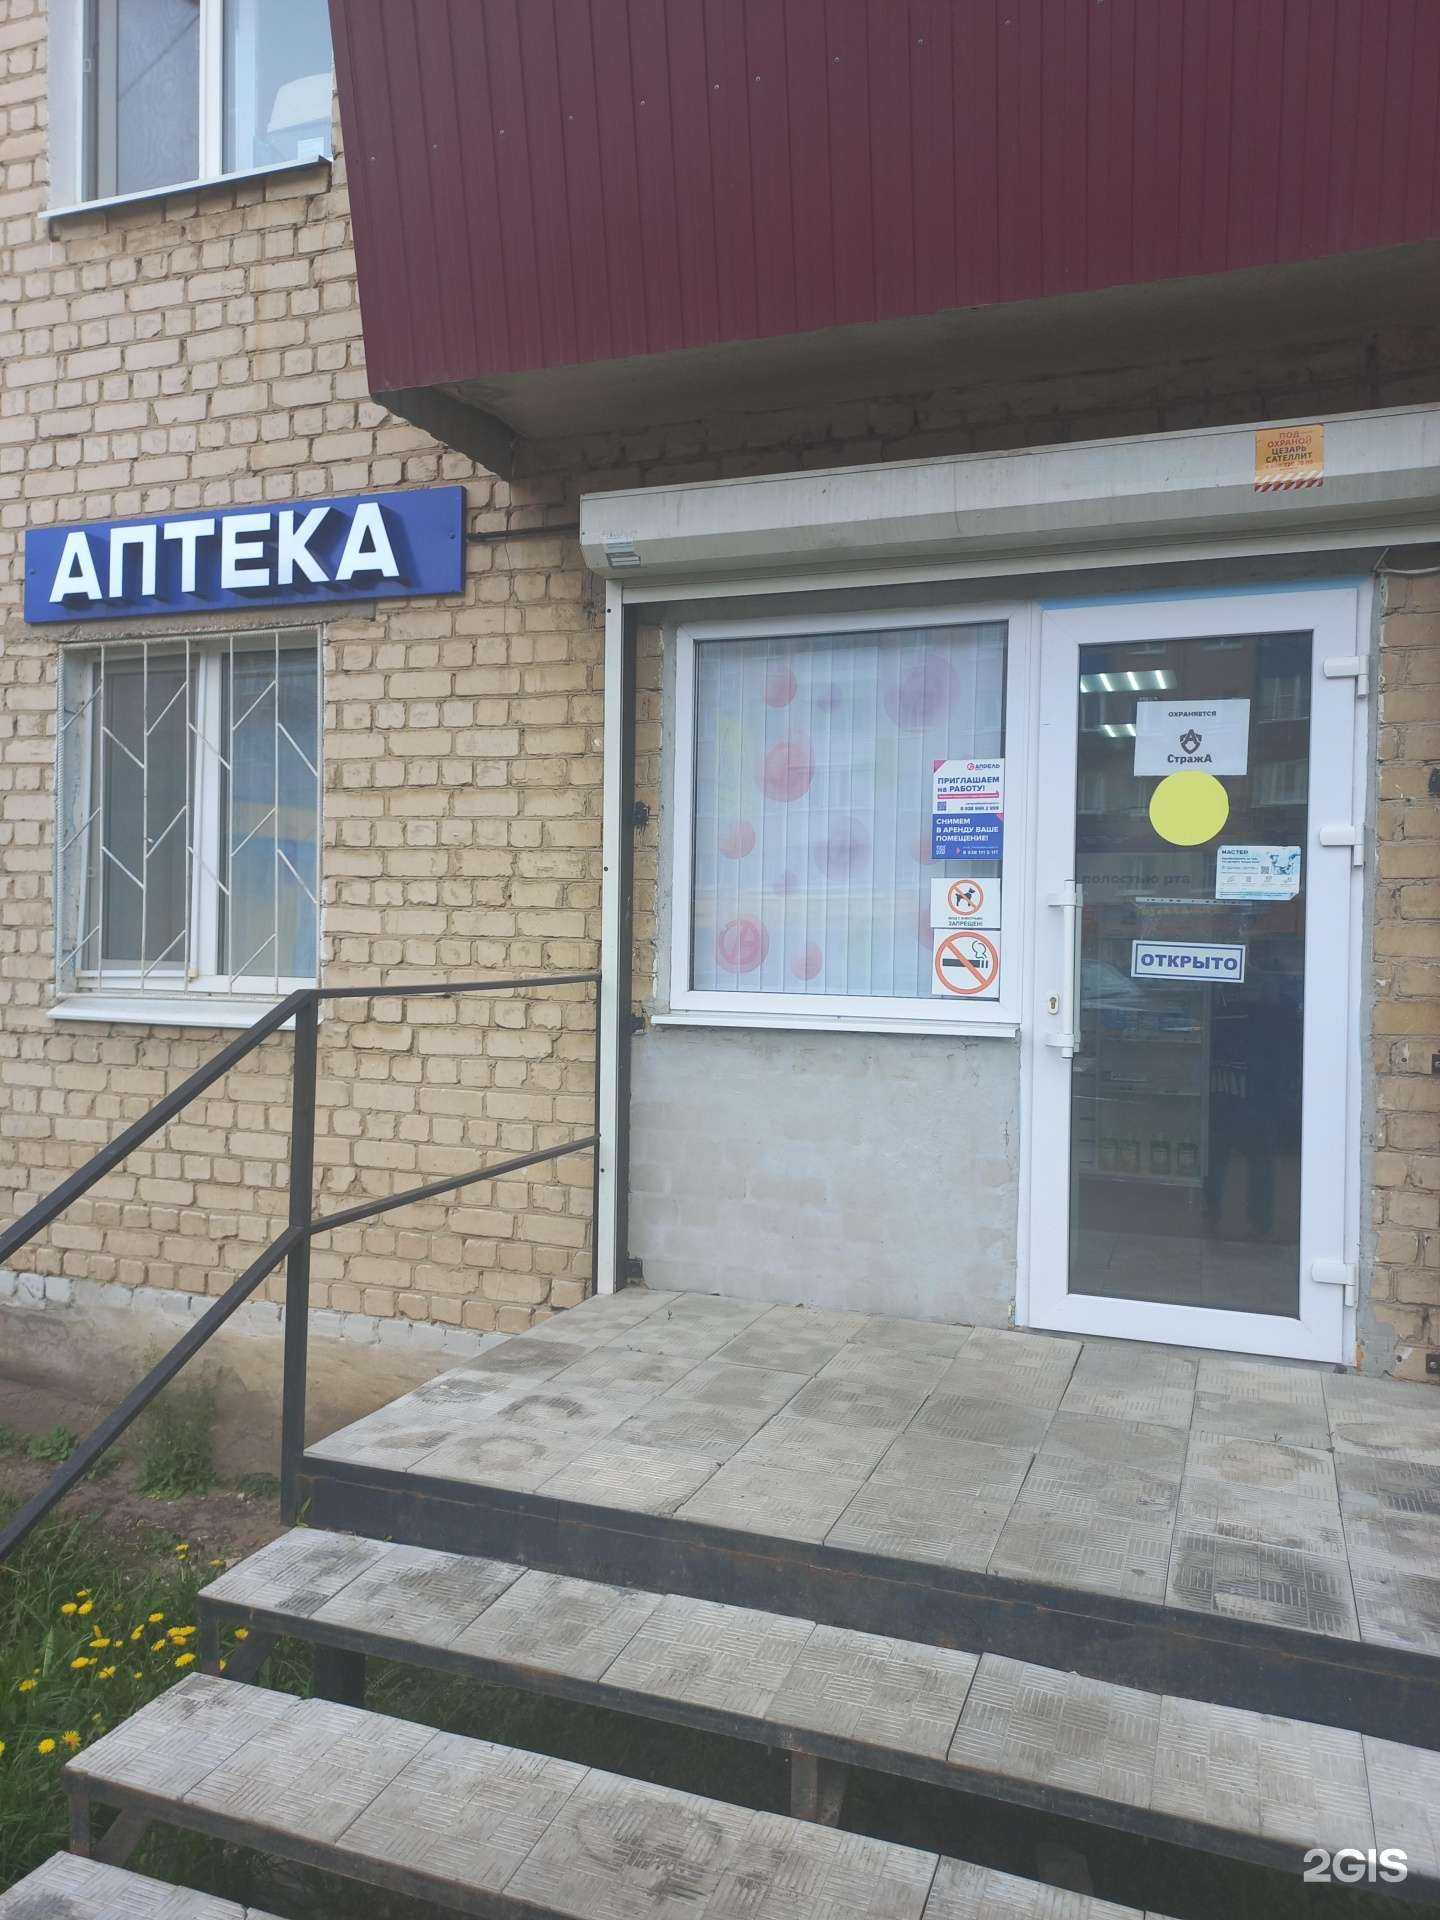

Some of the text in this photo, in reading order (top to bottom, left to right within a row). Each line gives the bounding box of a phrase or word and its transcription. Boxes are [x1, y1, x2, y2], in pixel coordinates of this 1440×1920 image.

[1267, 435, 1312, 448] ОХРАНОЙ
[1271, 445, 1307, 456] ЦЕЗАРЬ
[1265, 451, 1313, 464] САТЕЛЛИТ
[49, 502, 400, 603] АПТЕКА
[1168, 710, 1217, 718] ОХРАНЯЕТСЯ
[1167, 754, 1213, 765] СтражА
[937, 776, 1000, 785] ПРИГЛАШАЕМ
[1140, 953, 1238, 971] ОТКРЫТО
